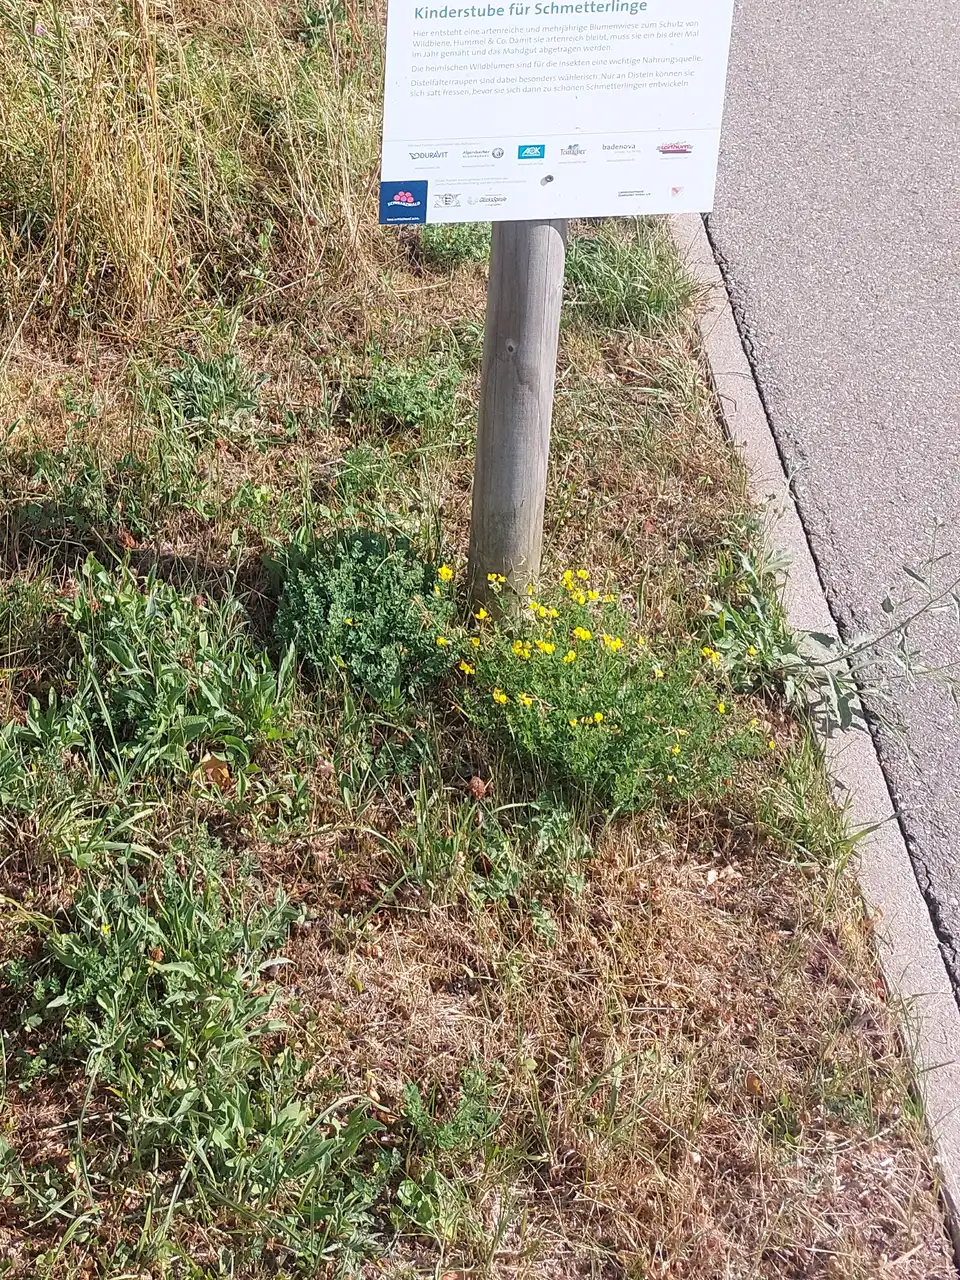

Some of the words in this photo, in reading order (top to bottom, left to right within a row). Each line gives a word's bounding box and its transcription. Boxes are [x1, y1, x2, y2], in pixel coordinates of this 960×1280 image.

[414, 5, 505, 20] Kinderstube
[508, 3, 530, 16] für
[534, 0, 648, 16] Schmetterlinge
[482, 26, 524, 34] artenreiche
[542, 23, 588, 33] mehrjährige
[454, 38, 486, 46] Hummel
[509, 36, 532, 44] Damit
[546, 33, 584, 42] artenreich
[441, 49, 470, 59] gemäht
[503, 47, 537, 56] Mahdgut
[538, 45, 581, 55] abgetragen
[426, 63, 468, 72] heimischen
[470, 61, 514, 70] Wildblumen
[534, 60, 544, 68] für
[559, 59, 590, 67] Insekten
[609, 56, 640, 66] wichtige
[411, 78, 477, 87] Distelfalterraupen
[497, 76, 517, 84] dabei
[519, 75, 556, 83] besonders
[628, 71, 654, 79] Disteln
[656, 70, 682, 78] können
[410, 89, 424, 97] sich
[472, 87, 492, 96] bevor
[506, 85, 520, 93] sich
[553, 84, 584, 92] schönen
[586, 82, 647, 92] Schmetterlingen
[649, 80, 688, 88] entwickeln
[419, 151, 448, 159] DURAVIT
